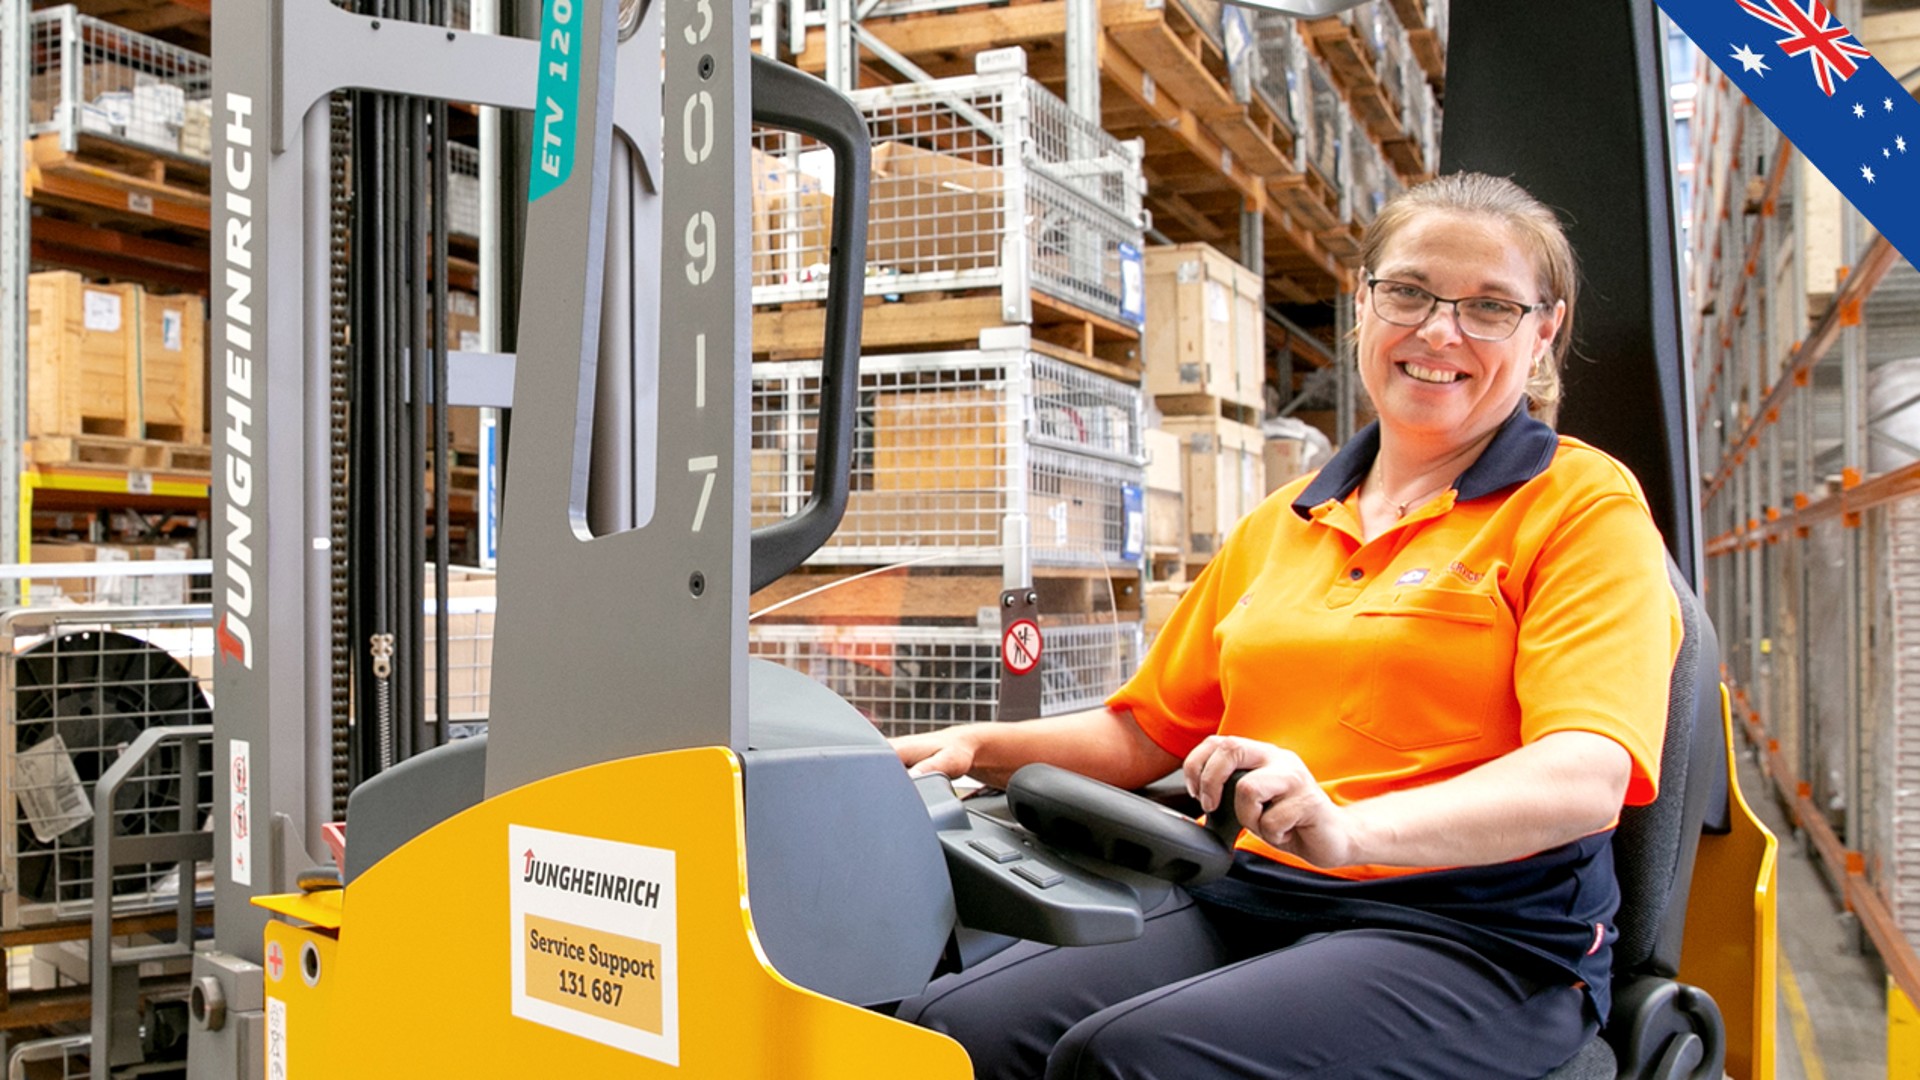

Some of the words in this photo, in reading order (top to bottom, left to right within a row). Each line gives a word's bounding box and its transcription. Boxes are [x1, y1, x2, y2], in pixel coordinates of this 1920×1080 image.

[550, 0, 573, 82] 120
[541, 96, 564, 178] ETV
[226, 92, 253, 671] JUNGHEINRICH
[523, 859, 661, 909] JUNGHEINRICH
[530, 929, 585, 962] Service
[588, 943, 656, 981] Support
[559, 969, 588, 998] 131
[591, 978, 624, 1008] 687
